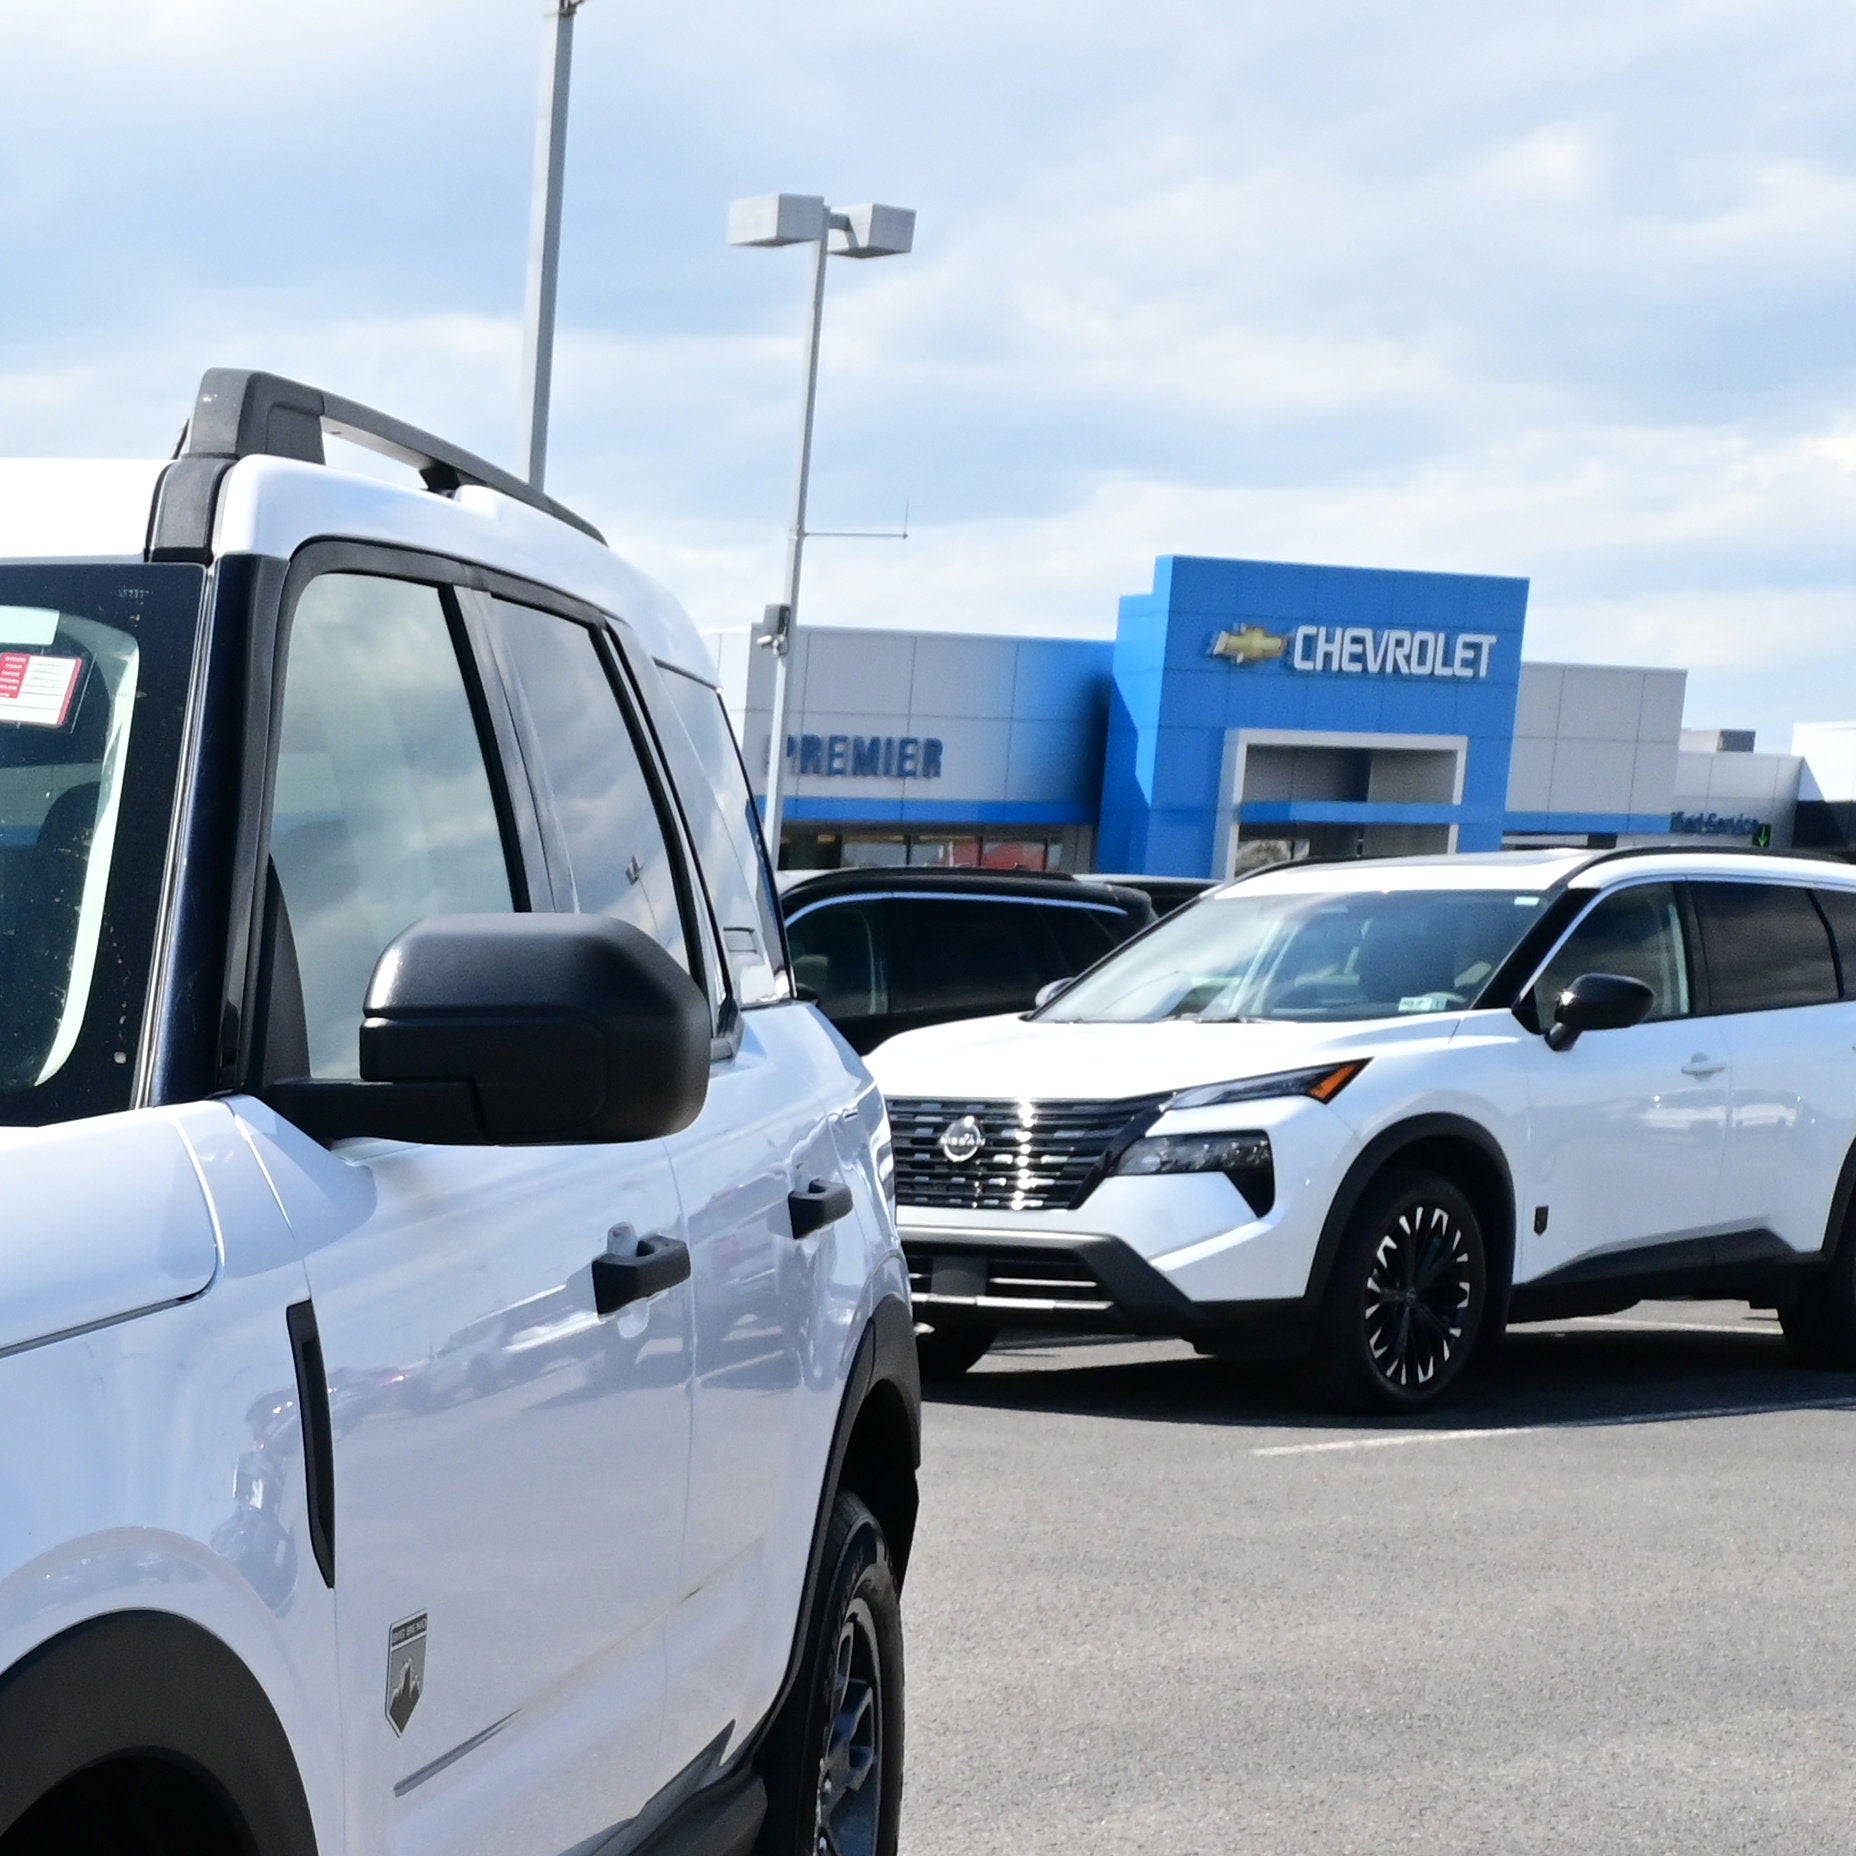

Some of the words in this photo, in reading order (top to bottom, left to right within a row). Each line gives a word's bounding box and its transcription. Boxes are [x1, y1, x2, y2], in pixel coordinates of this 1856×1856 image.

[1294, 625, 1497, 678] CHEVROLET
[940, 1133, 986, 1147] NISSAN
[392, 1629, 406, 1643] BIG
